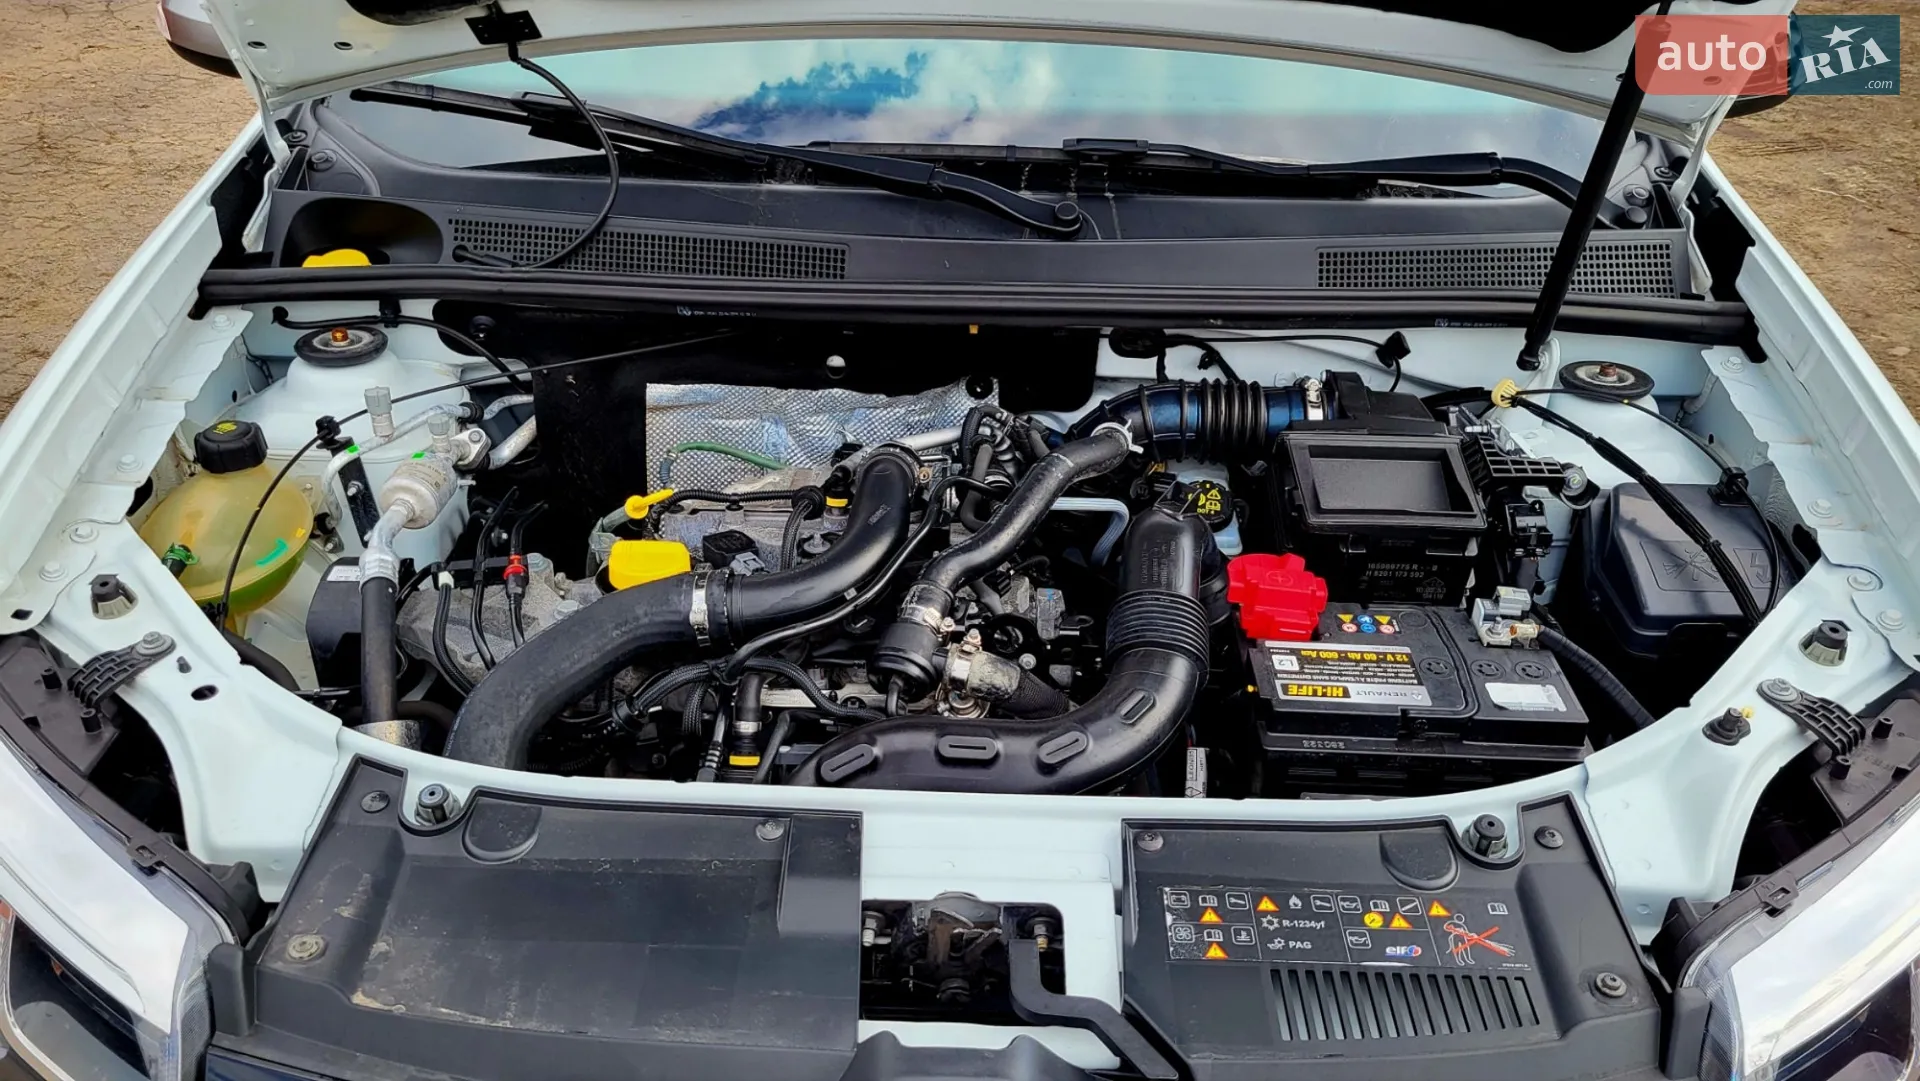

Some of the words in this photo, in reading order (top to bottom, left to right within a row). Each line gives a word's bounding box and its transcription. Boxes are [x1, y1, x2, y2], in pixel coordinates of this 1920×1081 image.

[1395, 654, 1408, 662] 12
[1282, 919, 1326, 930] R-1234yf
[1288, 940, 1312, 949] PAG
